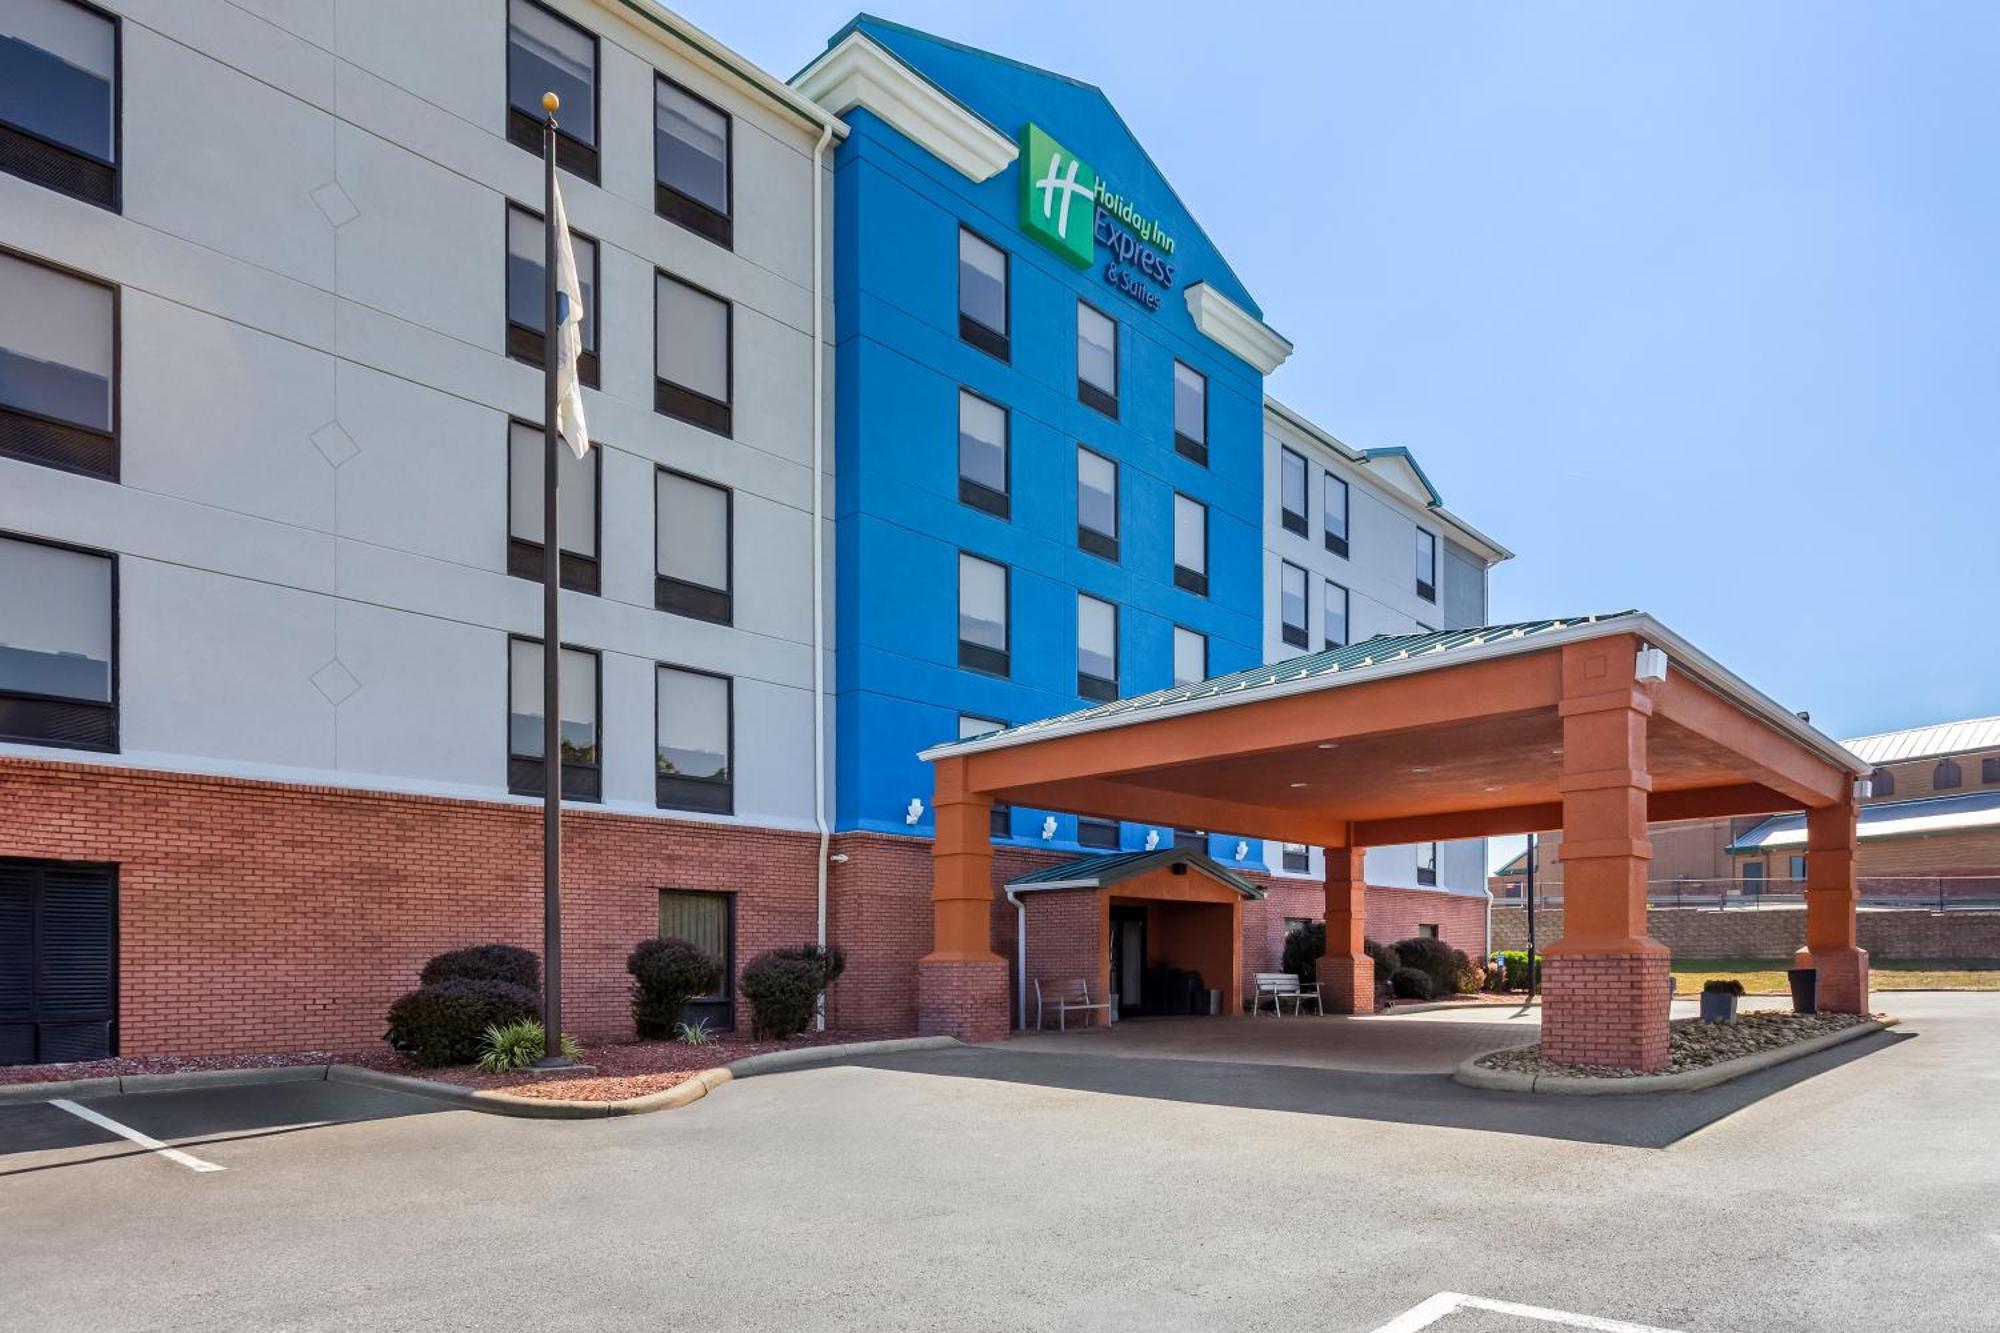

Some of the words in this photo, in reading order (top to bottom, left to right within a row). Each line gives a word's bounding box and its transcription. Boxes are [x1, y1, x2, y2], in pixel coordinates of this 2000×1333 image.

[1094, 175, 1151, 241] Holiday
[1152, 219, 1175, 254] Inn
[1094, 205, 1174, 288] Express
[1107, 261, 1119, 284] &
[1120, 271, 1160, 311] Suites
